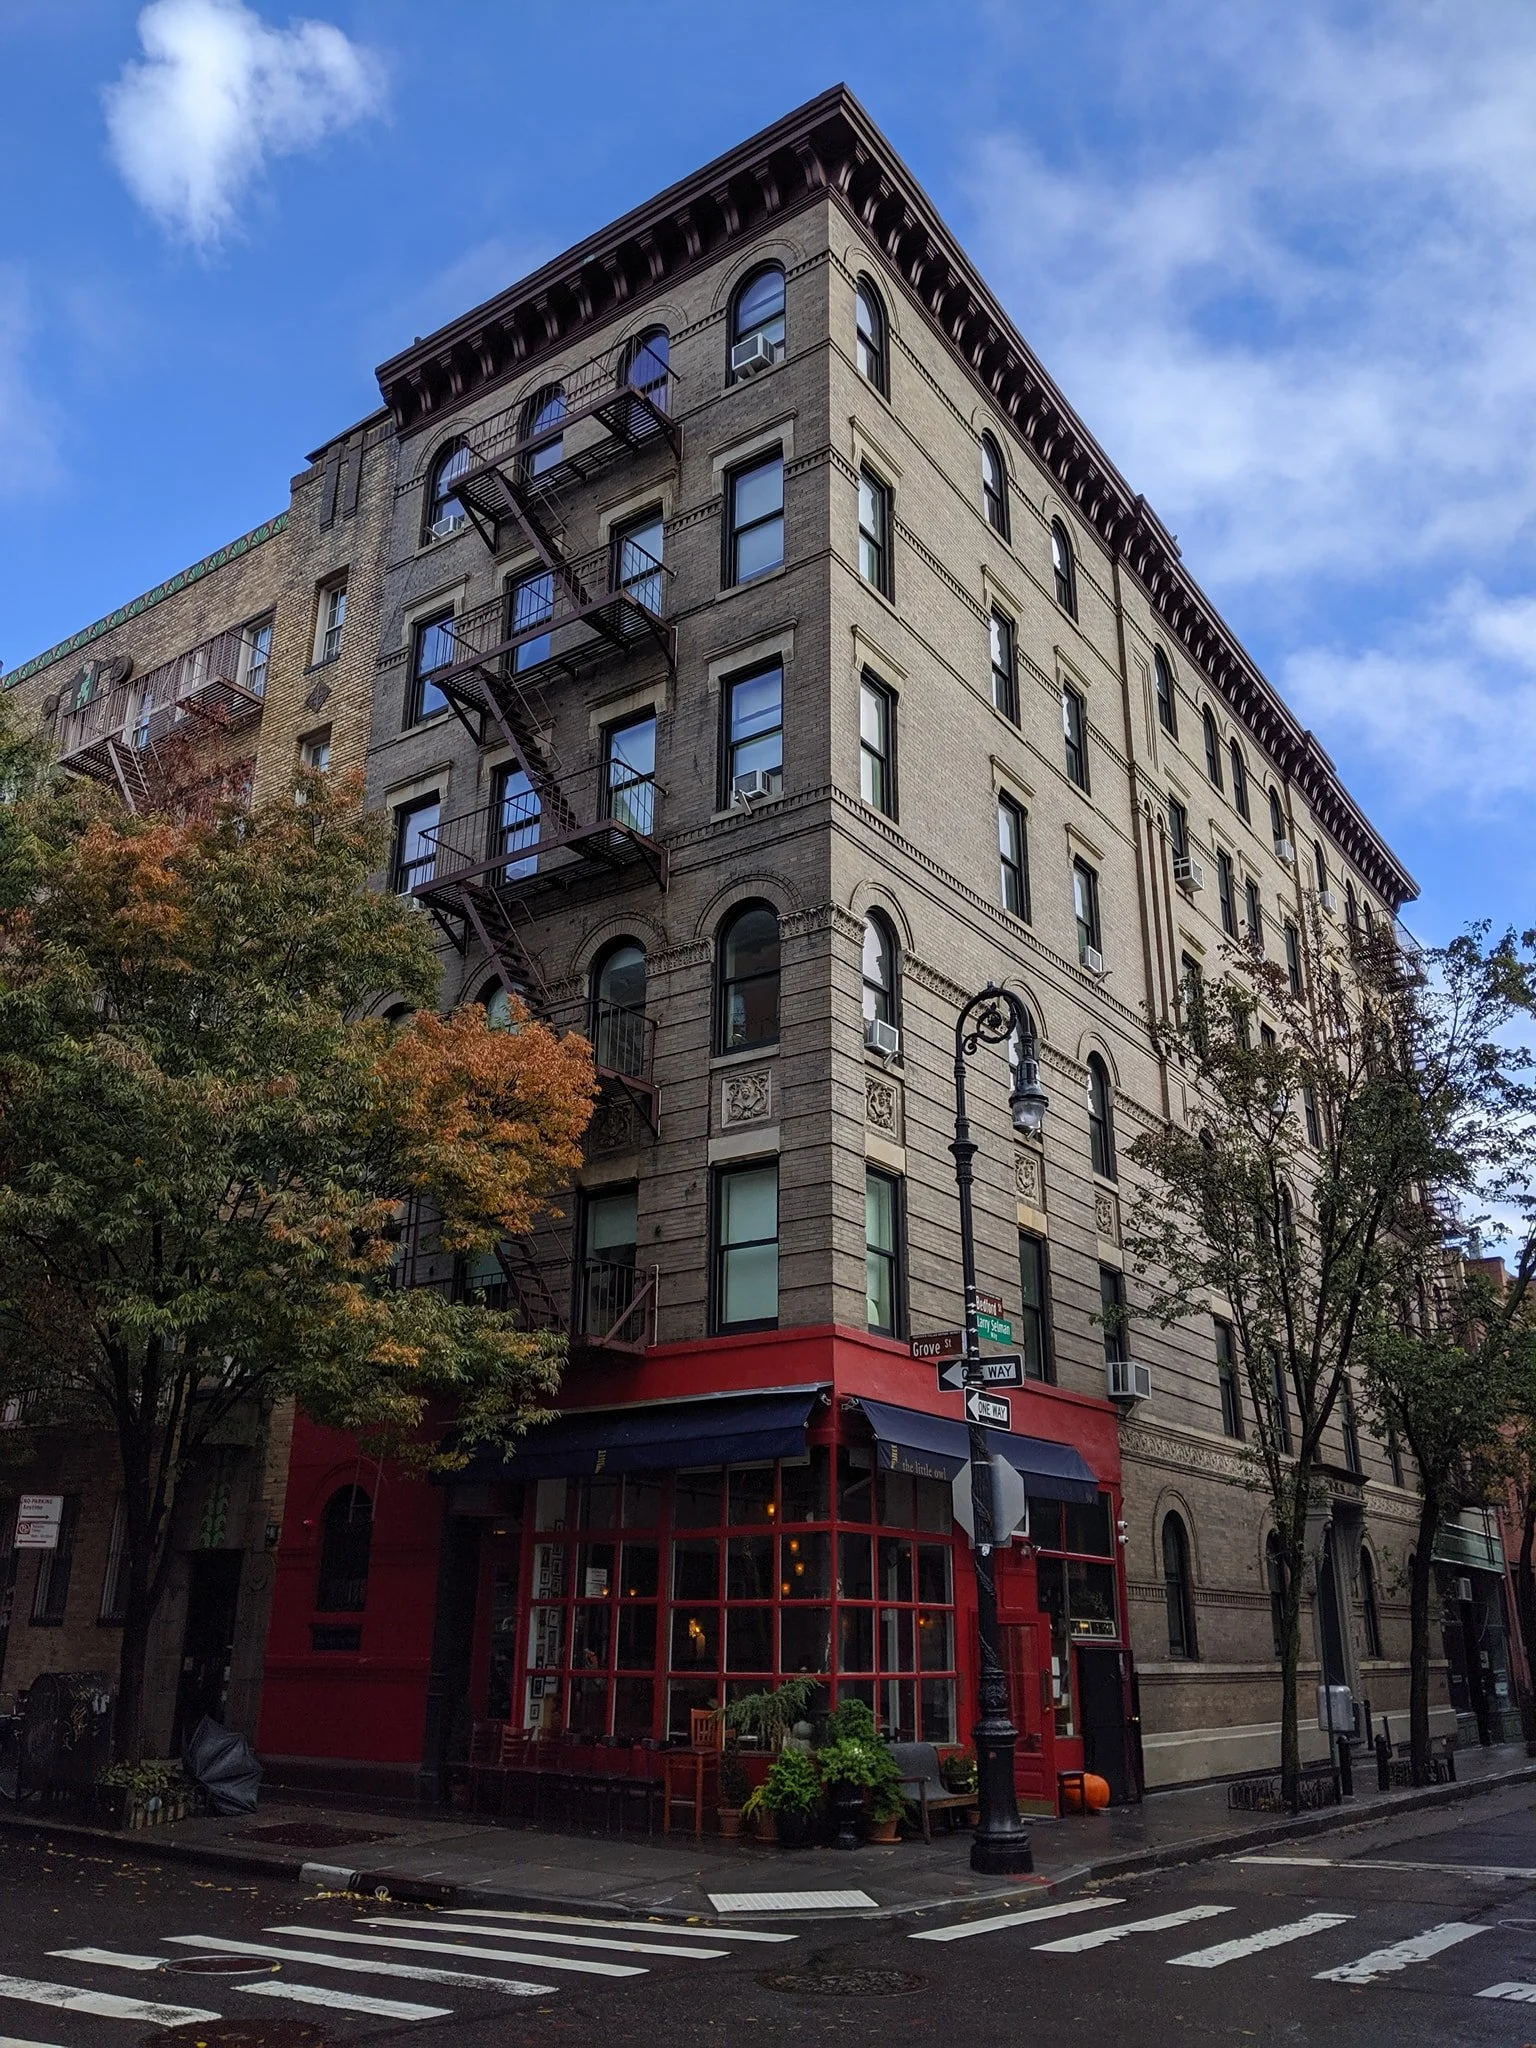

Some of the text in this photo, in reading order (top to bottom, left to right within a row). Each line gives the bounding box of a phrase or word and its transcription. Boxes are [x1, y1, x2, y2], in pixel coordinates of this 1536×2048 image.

[977, 1315, 1011, 1335] Larry Selman
[913, 1338, 952, 1357] Grove St
[988, 1365, 1012, 1378] WAY
[978, 1401, 1006, 1419] ONE WAY
[902, 1459, 947, 1480] the little owl
